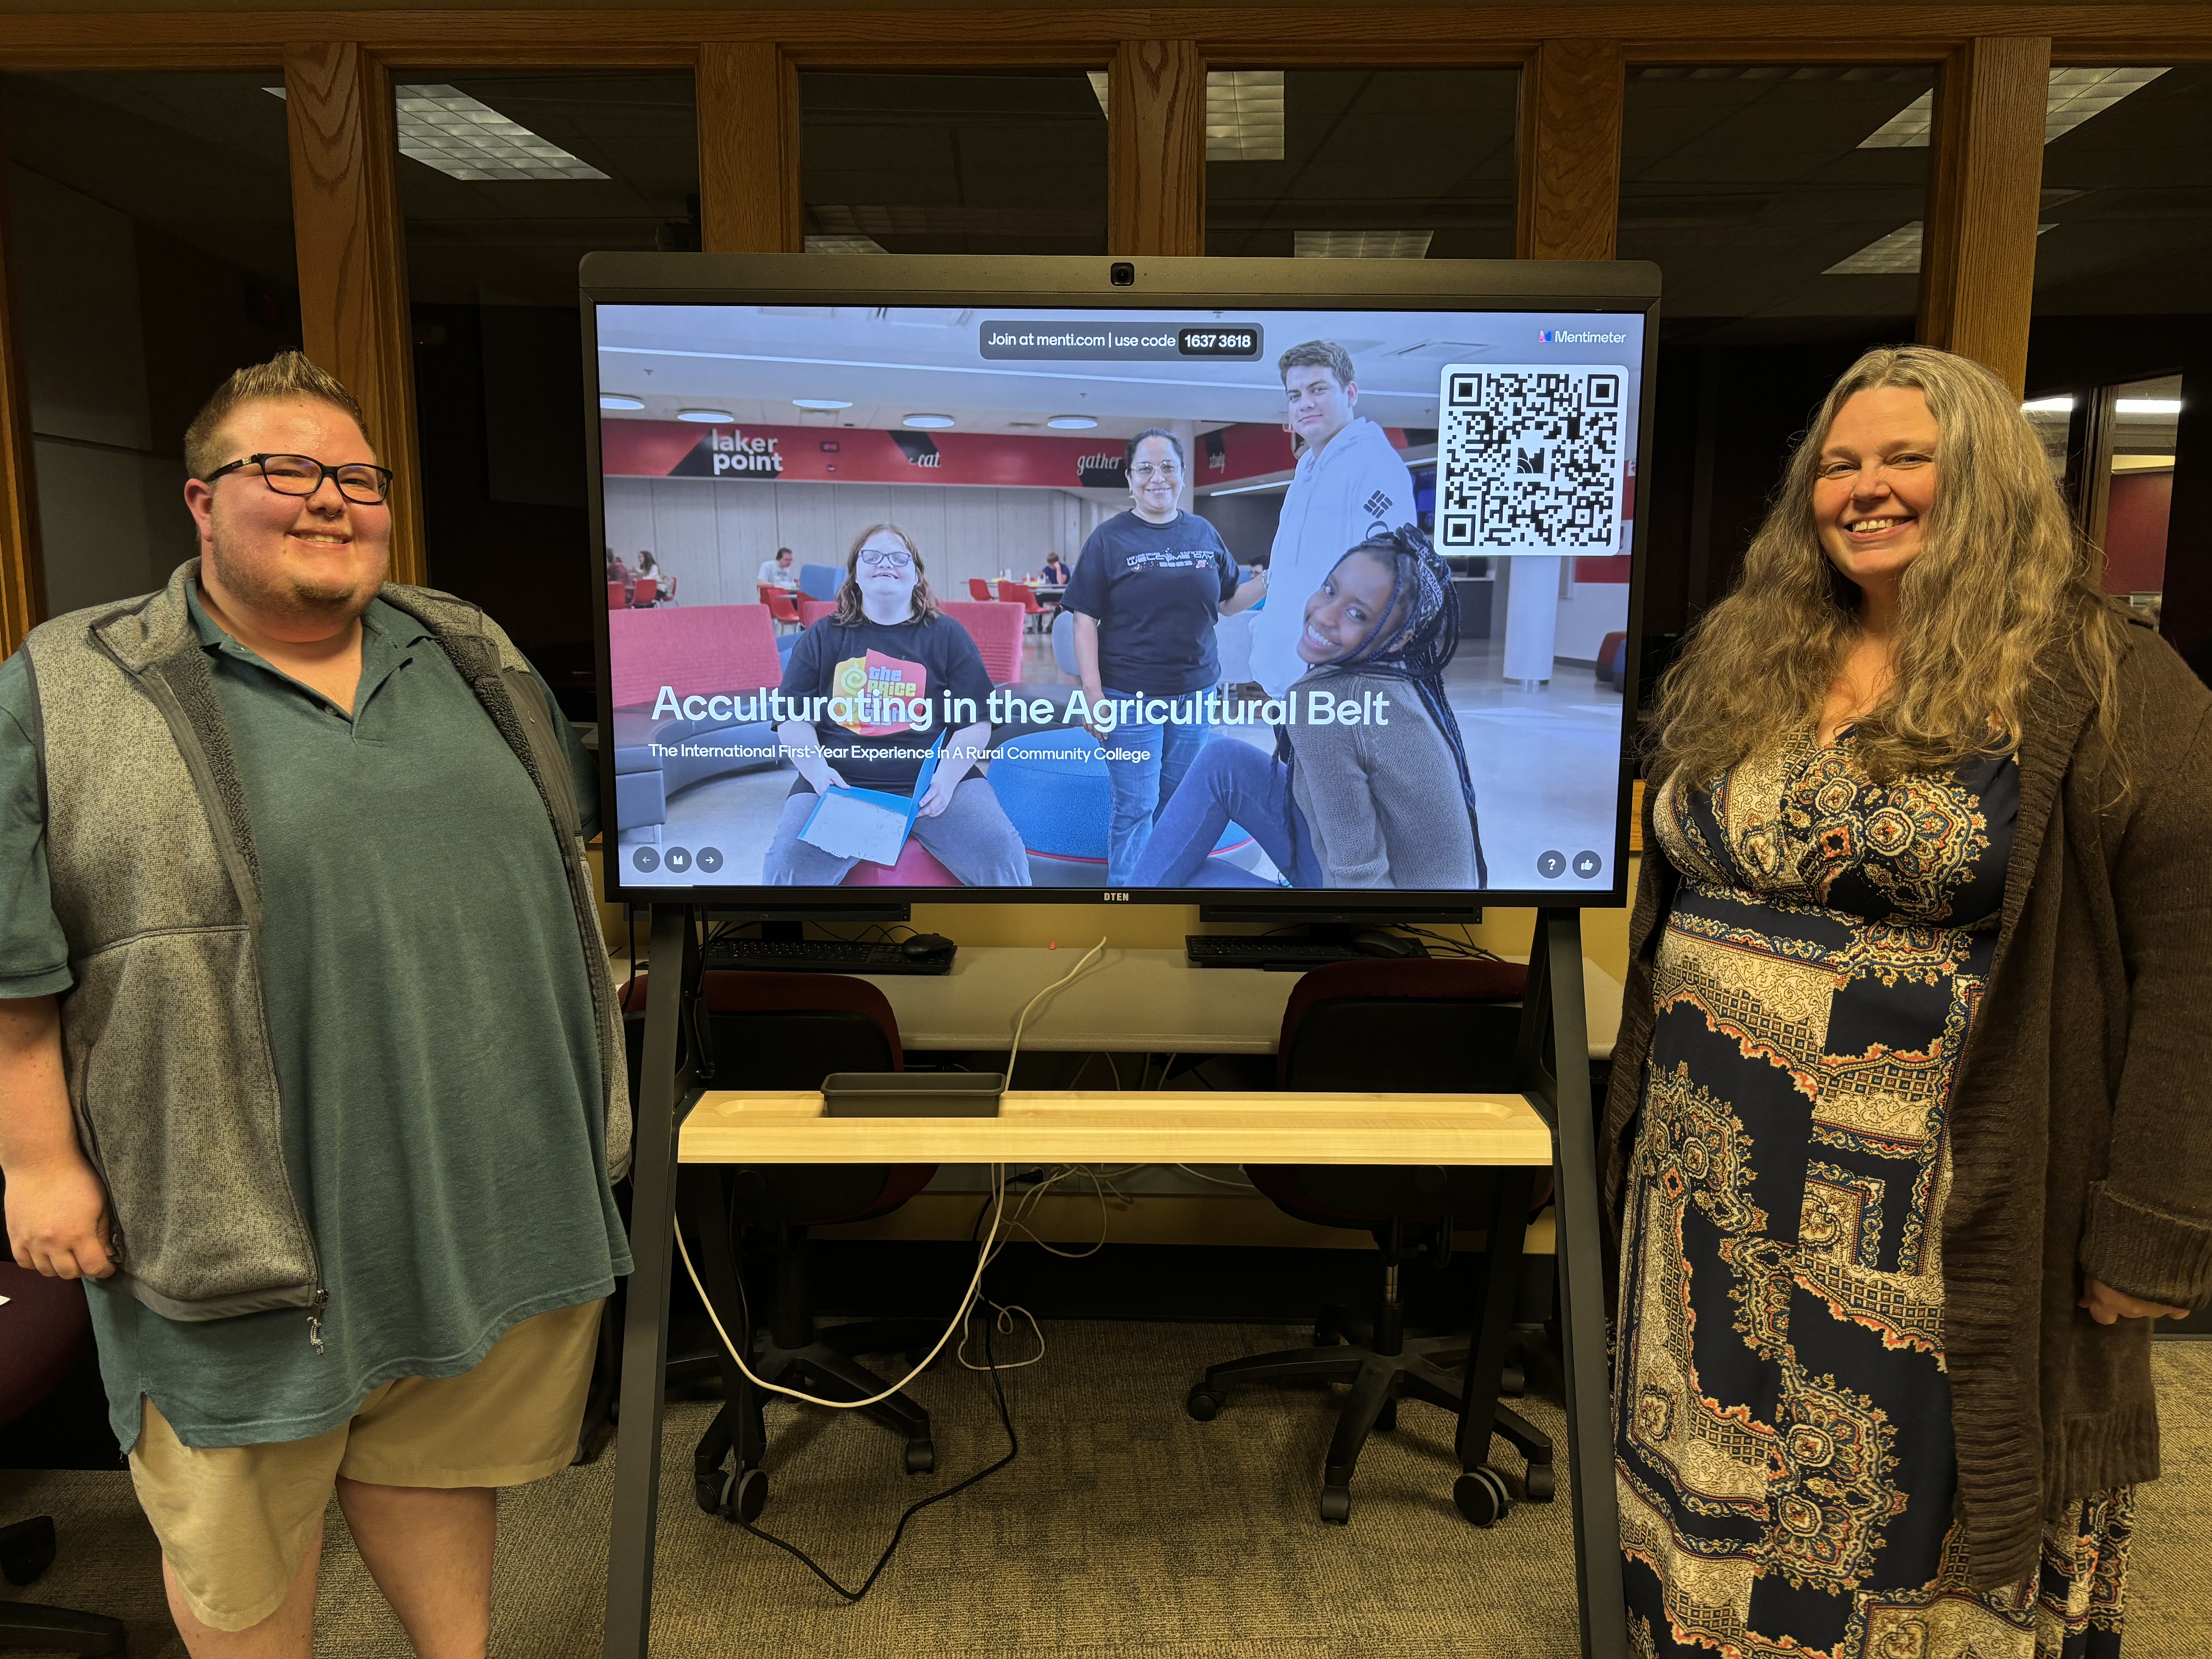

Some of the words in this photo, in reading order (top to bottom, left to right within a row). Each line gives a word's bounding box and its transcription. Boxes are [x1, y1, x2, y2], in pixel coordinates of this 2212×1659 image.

[988, 333, 1017, 345] Join
[1019, 333, 1034, 345] at
[1037, 333, 1105, 346] menti.com
[1115, 336, 1139, 347] use
[1141, 334, 1176, 347] code
[1184, 334, 1217, 348] 1637
[1218, 334, 1252, 348] 3618
[1554, 330, 1626, 343] Mentimeter
[712, 428, 779, 453] laker
[713, 452, 784, 475] point
[1077, 452, 1123, 476] gather
[869, 666, 902, 682] the
[651, 685, 933, 732] Acculturating
[943, 689, 977, 723] in
[986, 689, 1055, 724] the
[1062, 690, 1297, 733] Agricultural
[1308, 690, 1390, 726] Belt
[647, 743, 678, 757] The
[681, 743, 776, 758] International
[778, 744, 849, 759] First-Year
[851, 745, 934, 762] Experience
[937, 745, 950, 759] in
[952, 746, 964, 759] A
[966, 746, 1004, 760] Rural
[1006, 746, 1091, 763] Community
[1094, 747, 1151, 764] College
[1104, 892, 1129, 902] DTEN
